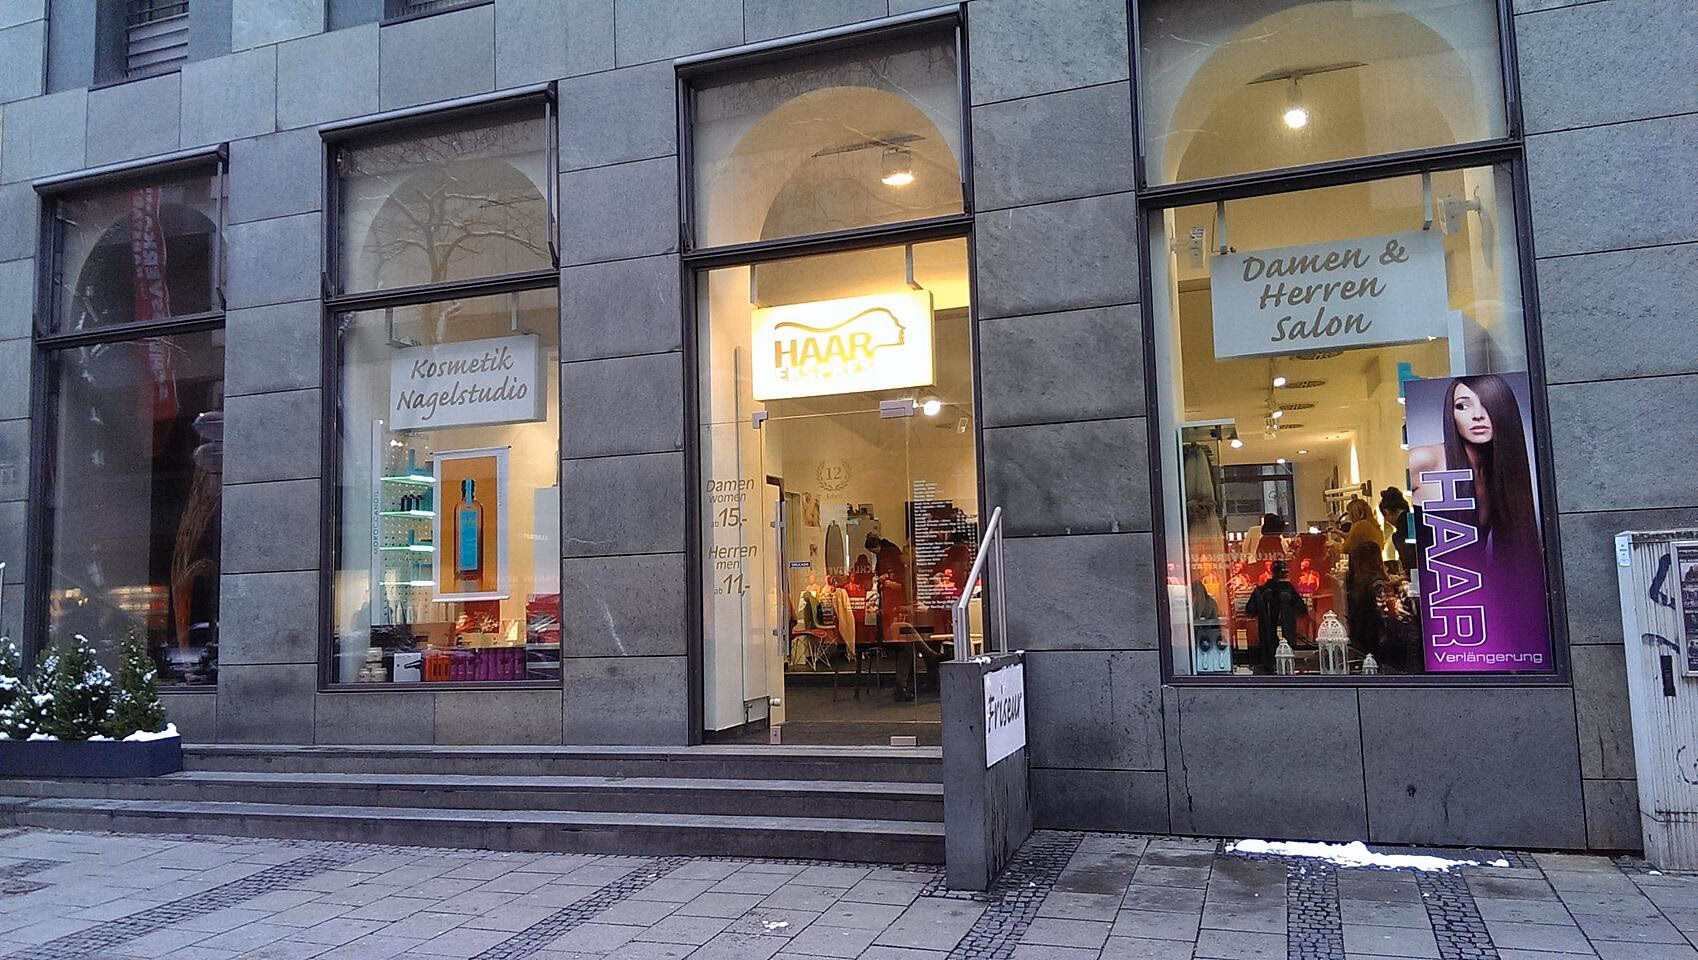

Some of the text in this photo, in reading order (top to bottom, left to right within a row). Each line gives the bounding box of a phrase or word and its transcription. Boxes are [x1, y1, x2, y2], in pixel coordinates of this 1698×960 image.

[1243, 239, 1409, 282] Damen &
[1259, 277, 1387, 310] Herren
[1271, 306, 1372, 342] Salon
[411, 346, 514, 380] Kosmetik
[774, 332, 876, 369] HAAR
[396, 376, 528, 420] Nagelstudio
[706, 479, 755, 493] Damen
[826, 467, 842, 480] 12
[709, 492, 747, 503] women
[708, 545, 758, 560] Herren
[715, 560, 741, 571] men
[1419, 469, 1487, 647] HAAR
[1434, 651, 1543, 664] Verlängerung
[988, 685, 1023, 733] Friseur
